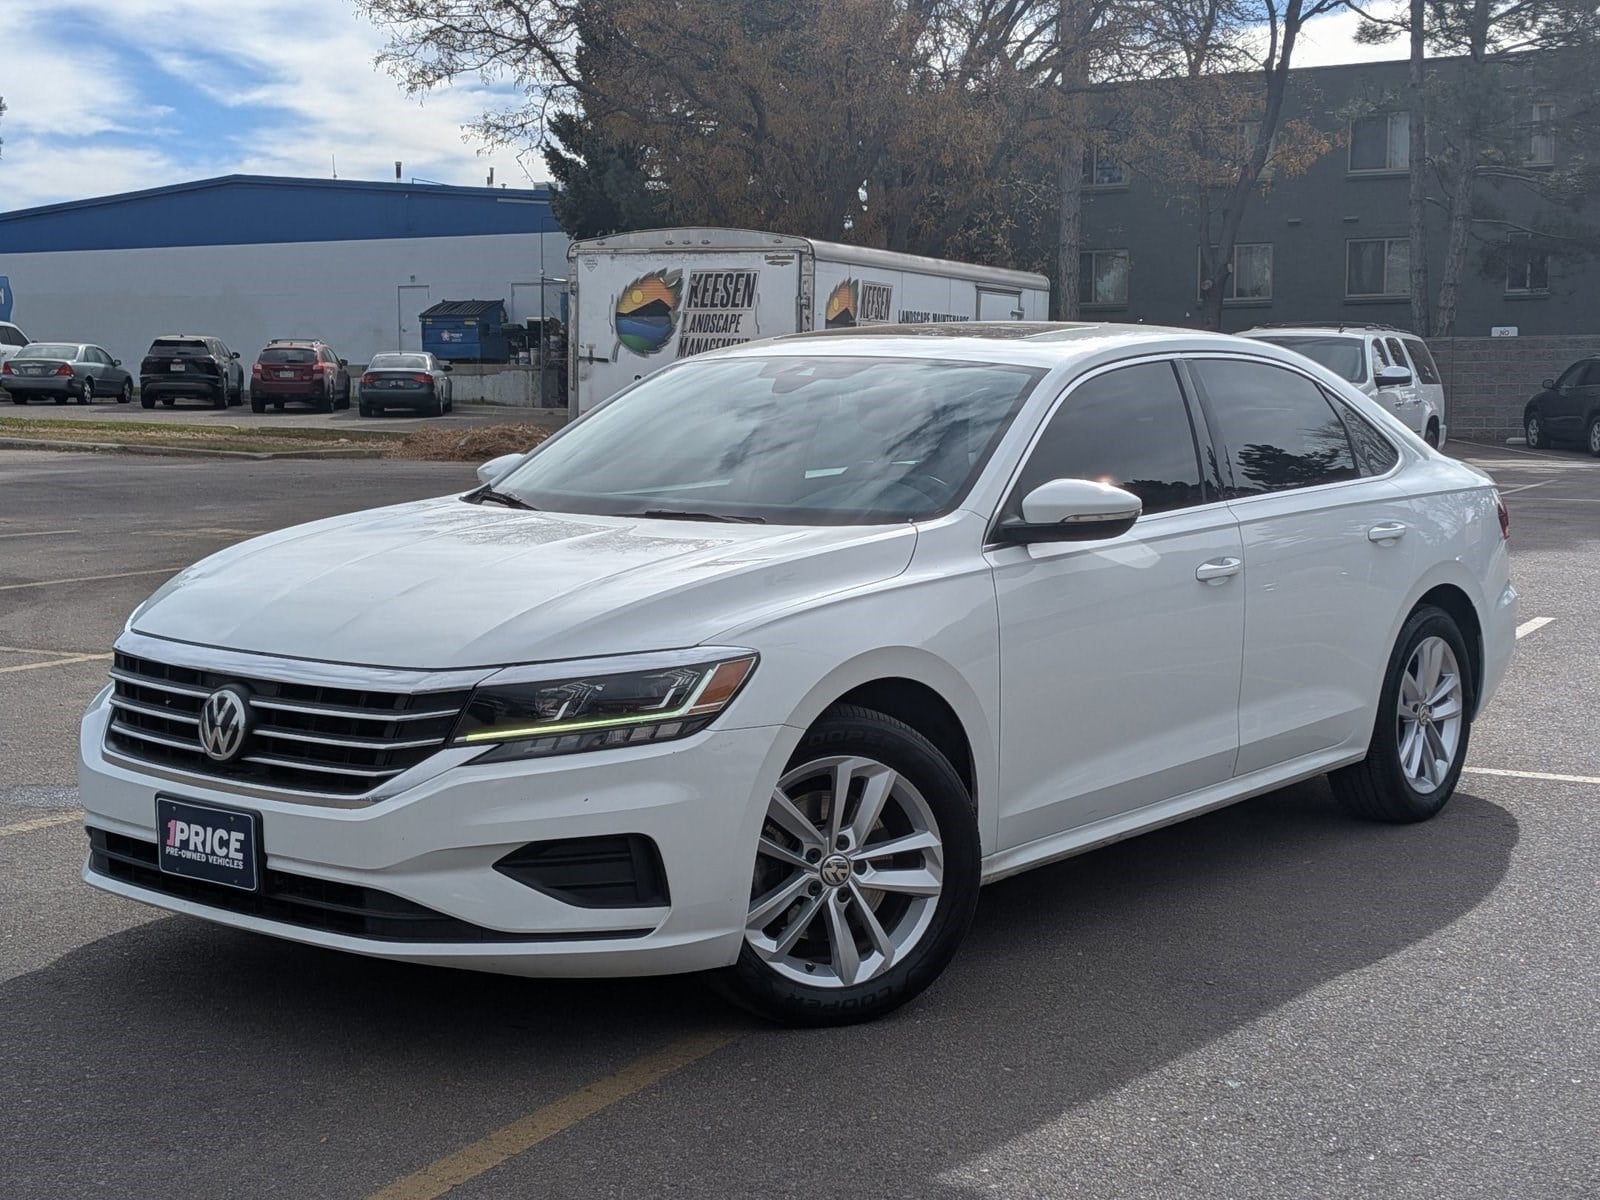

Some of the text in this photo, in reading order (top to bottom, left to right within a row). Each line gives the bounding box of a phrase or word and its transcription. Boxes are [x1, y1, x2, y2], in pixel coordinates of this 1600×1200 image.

[686, 272, 757, 309] KEESEN
[860, 285, 892, 320] KEESEN
[681, 312, 743, 334] LANDSCAPE
[677, 337, 751, 358] MANAGE
[166, 819, 245, 860] 1PRICE
[165, 846, 244, 870] PRE-OWNED VEHICLES
